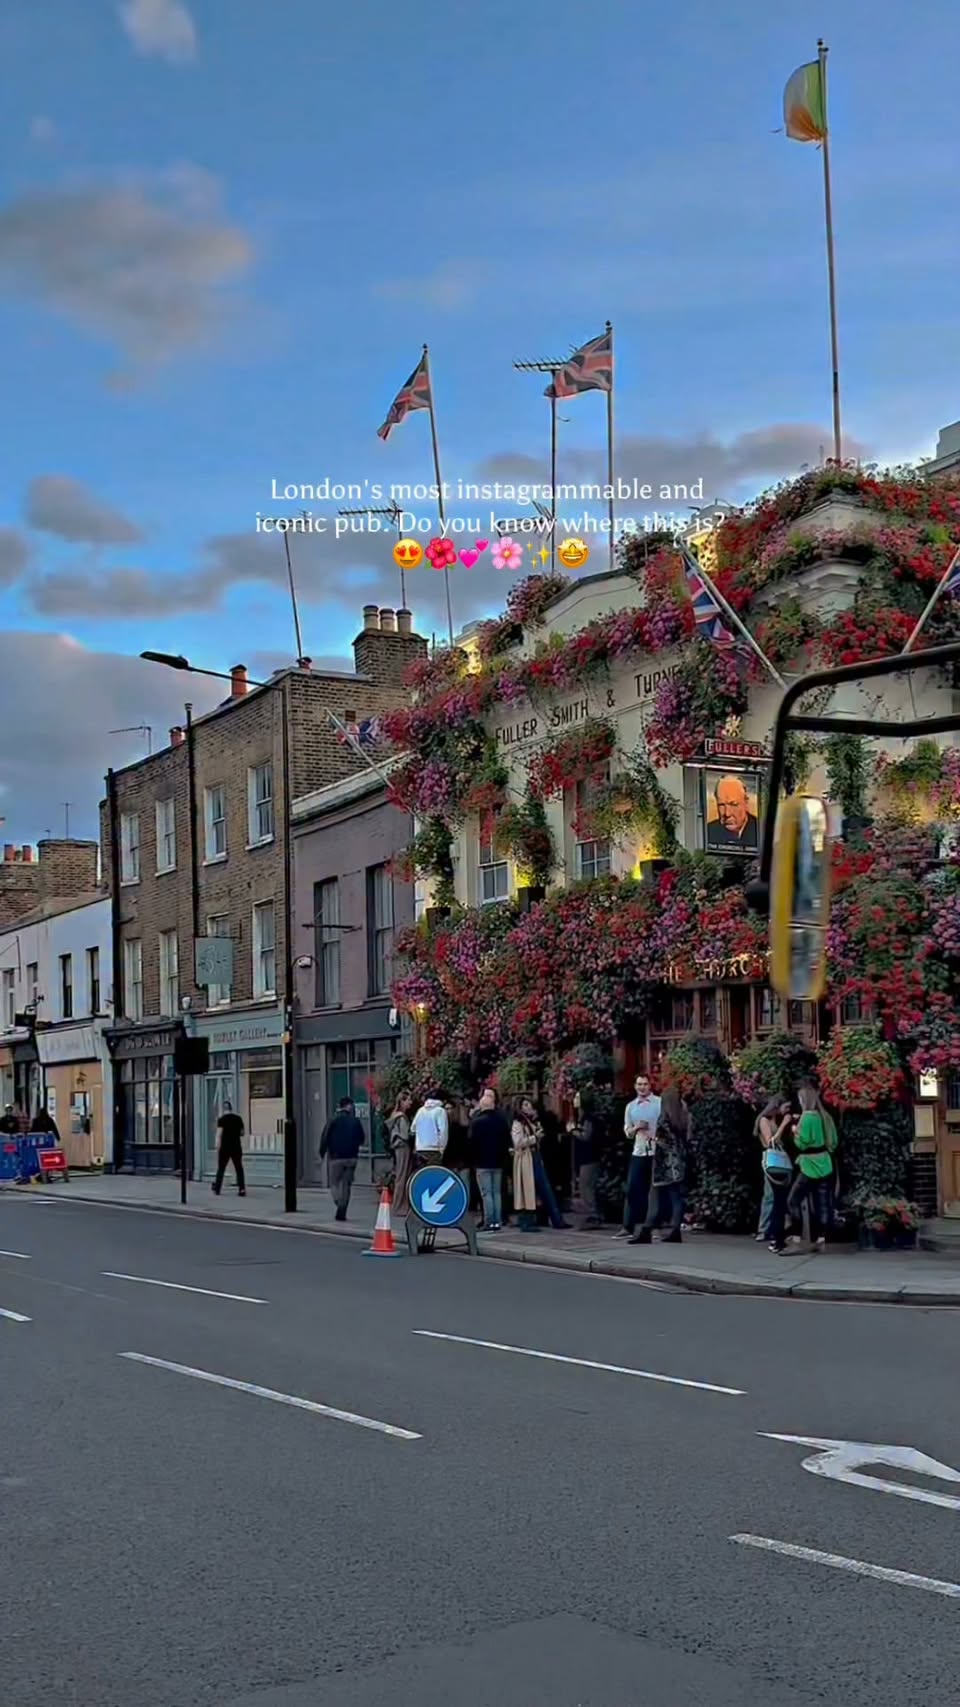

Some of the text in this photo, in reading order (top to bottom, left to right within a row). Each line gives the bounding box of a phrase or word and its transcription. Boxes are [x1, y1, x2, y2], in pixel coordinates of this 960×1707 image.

[495, 718, 538, 748] FULLER
[551, 698, 589, 727] SMITH
[606, 688, 616, 708] &
